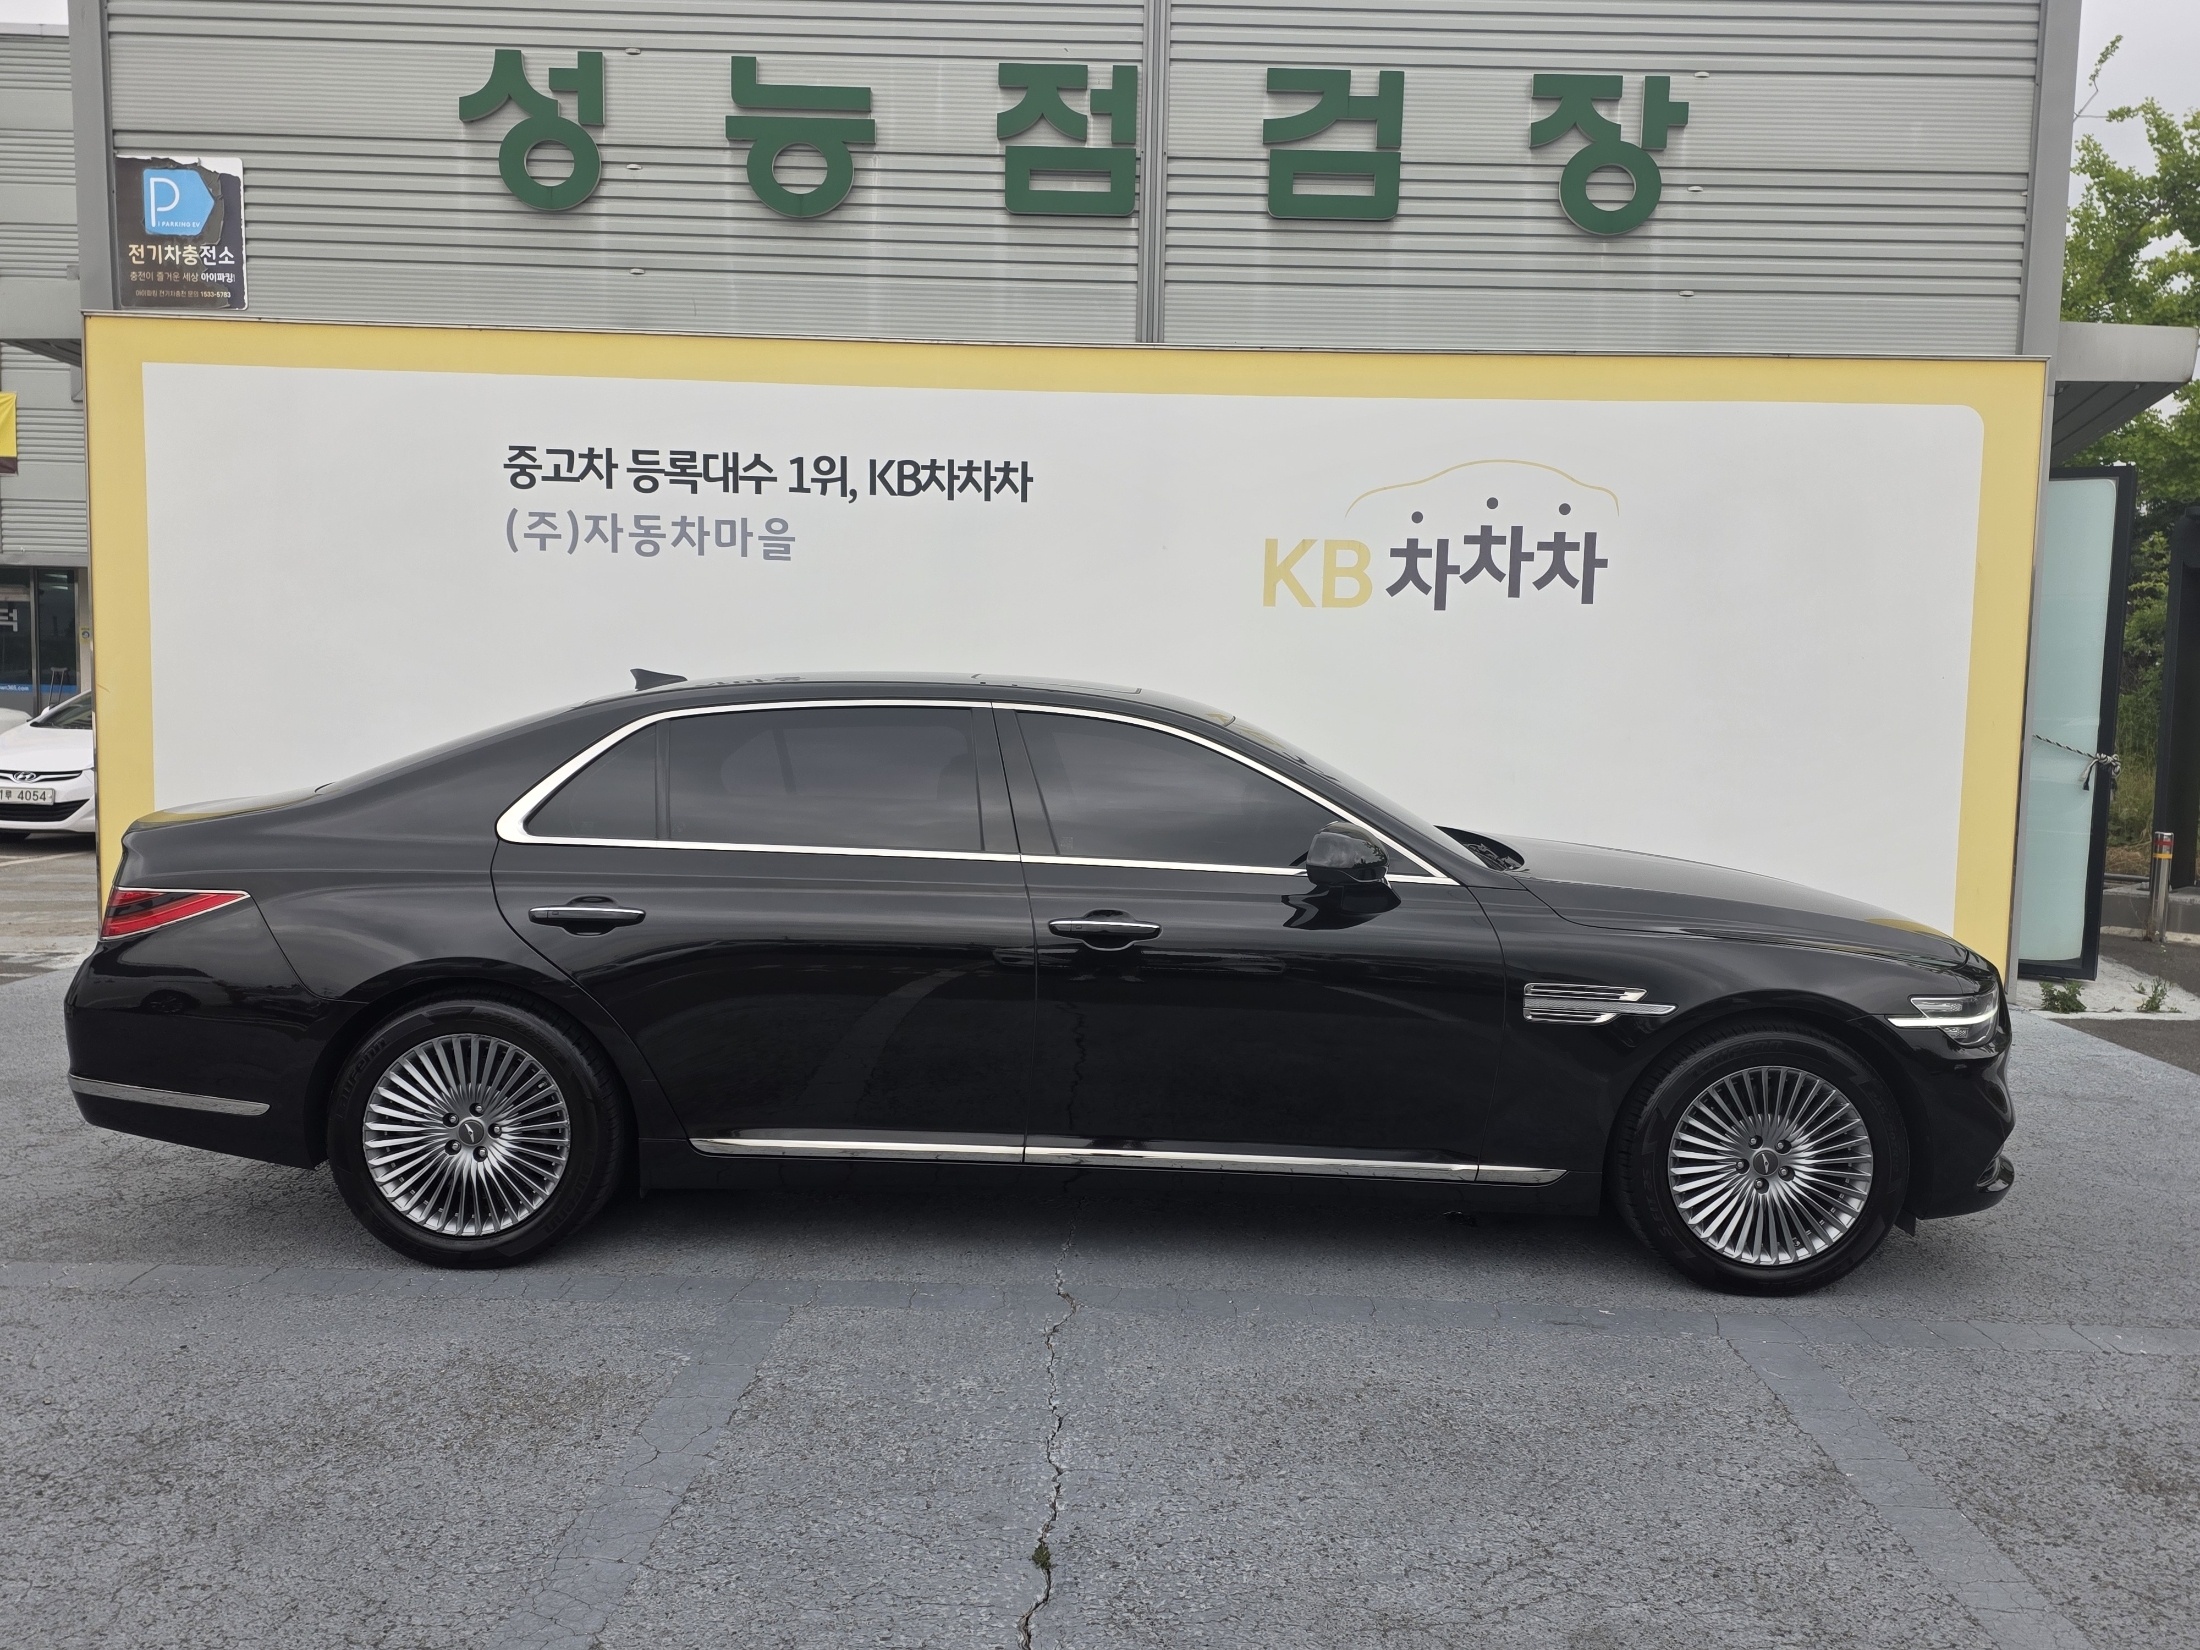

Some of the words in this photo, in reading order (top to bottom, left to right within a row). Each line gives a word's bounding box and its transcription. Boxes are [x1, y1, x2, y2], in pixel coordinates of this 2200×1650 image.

[459, 49, 1689, 236] 성능점검장
[150, 178, 180, 227] P
[128, 244, 235, 265] 전기차충전소
[130, 271, 154, 281] 충전이
[156, 272, 180, 281] 즐거운
[183, 272, 198, 282] 세상
[201, 272, 235, 282] 아이파킹
[503, 446, 618, 489] 중고차
[626, 448, 778, 494] 등록대수
[788, 455, 859, 503] 1위,
[870, 458, 1034, 502] KB차차차
[506, 508, 796, 561] (주)자동차마을
[17, 790, 46, 801] 4054
